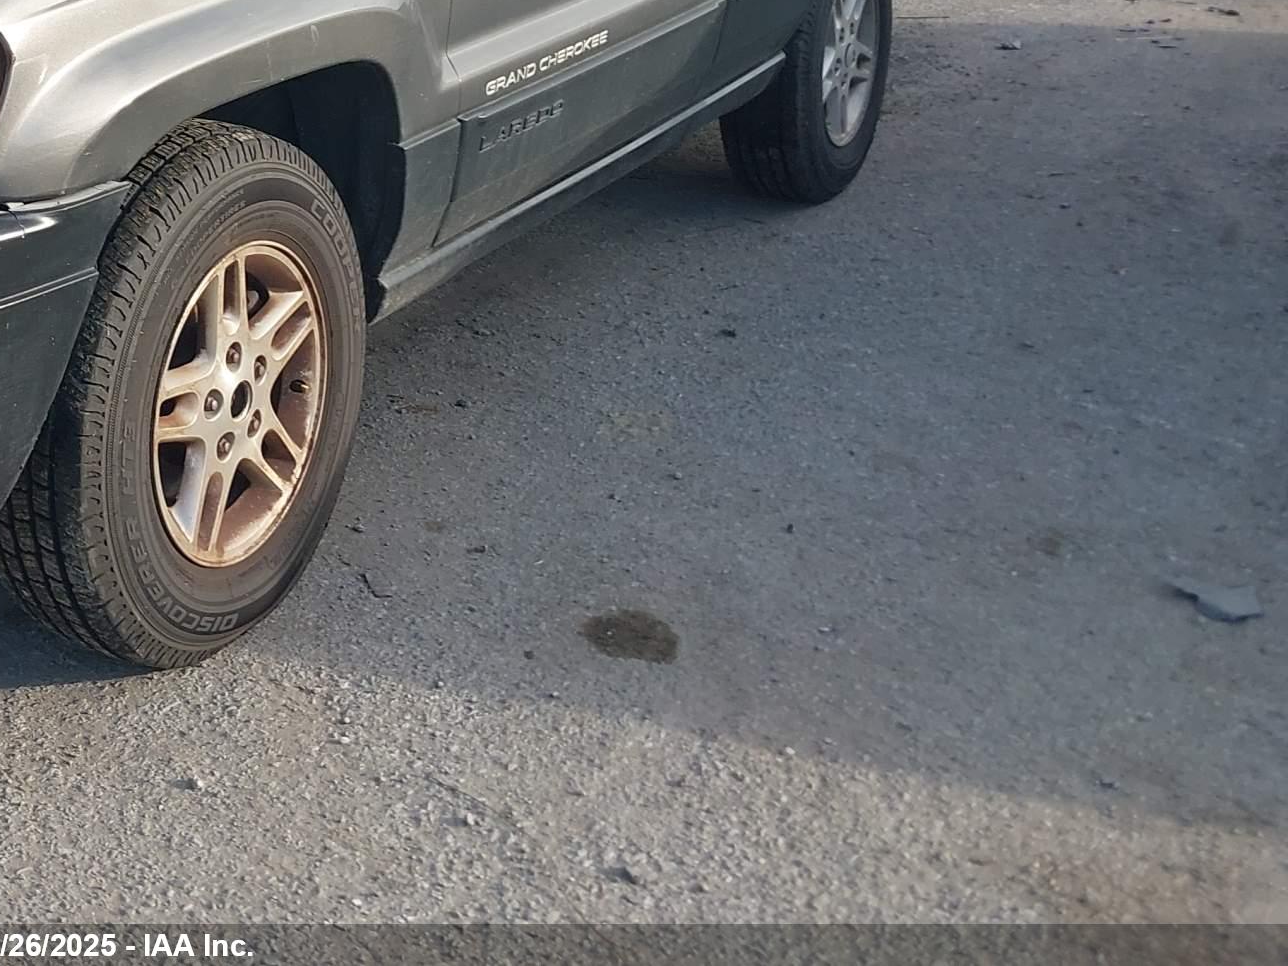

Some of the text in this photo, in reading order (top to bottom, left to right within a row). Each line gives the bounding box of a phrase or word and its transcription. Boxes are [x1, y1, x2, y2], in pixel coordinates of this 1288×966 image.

[485, 29, 609, 96] GRAND CHEROKEE
[311, 199, 361, 332] COOPER
[125, 516, 239, 633] DISCOVERER
